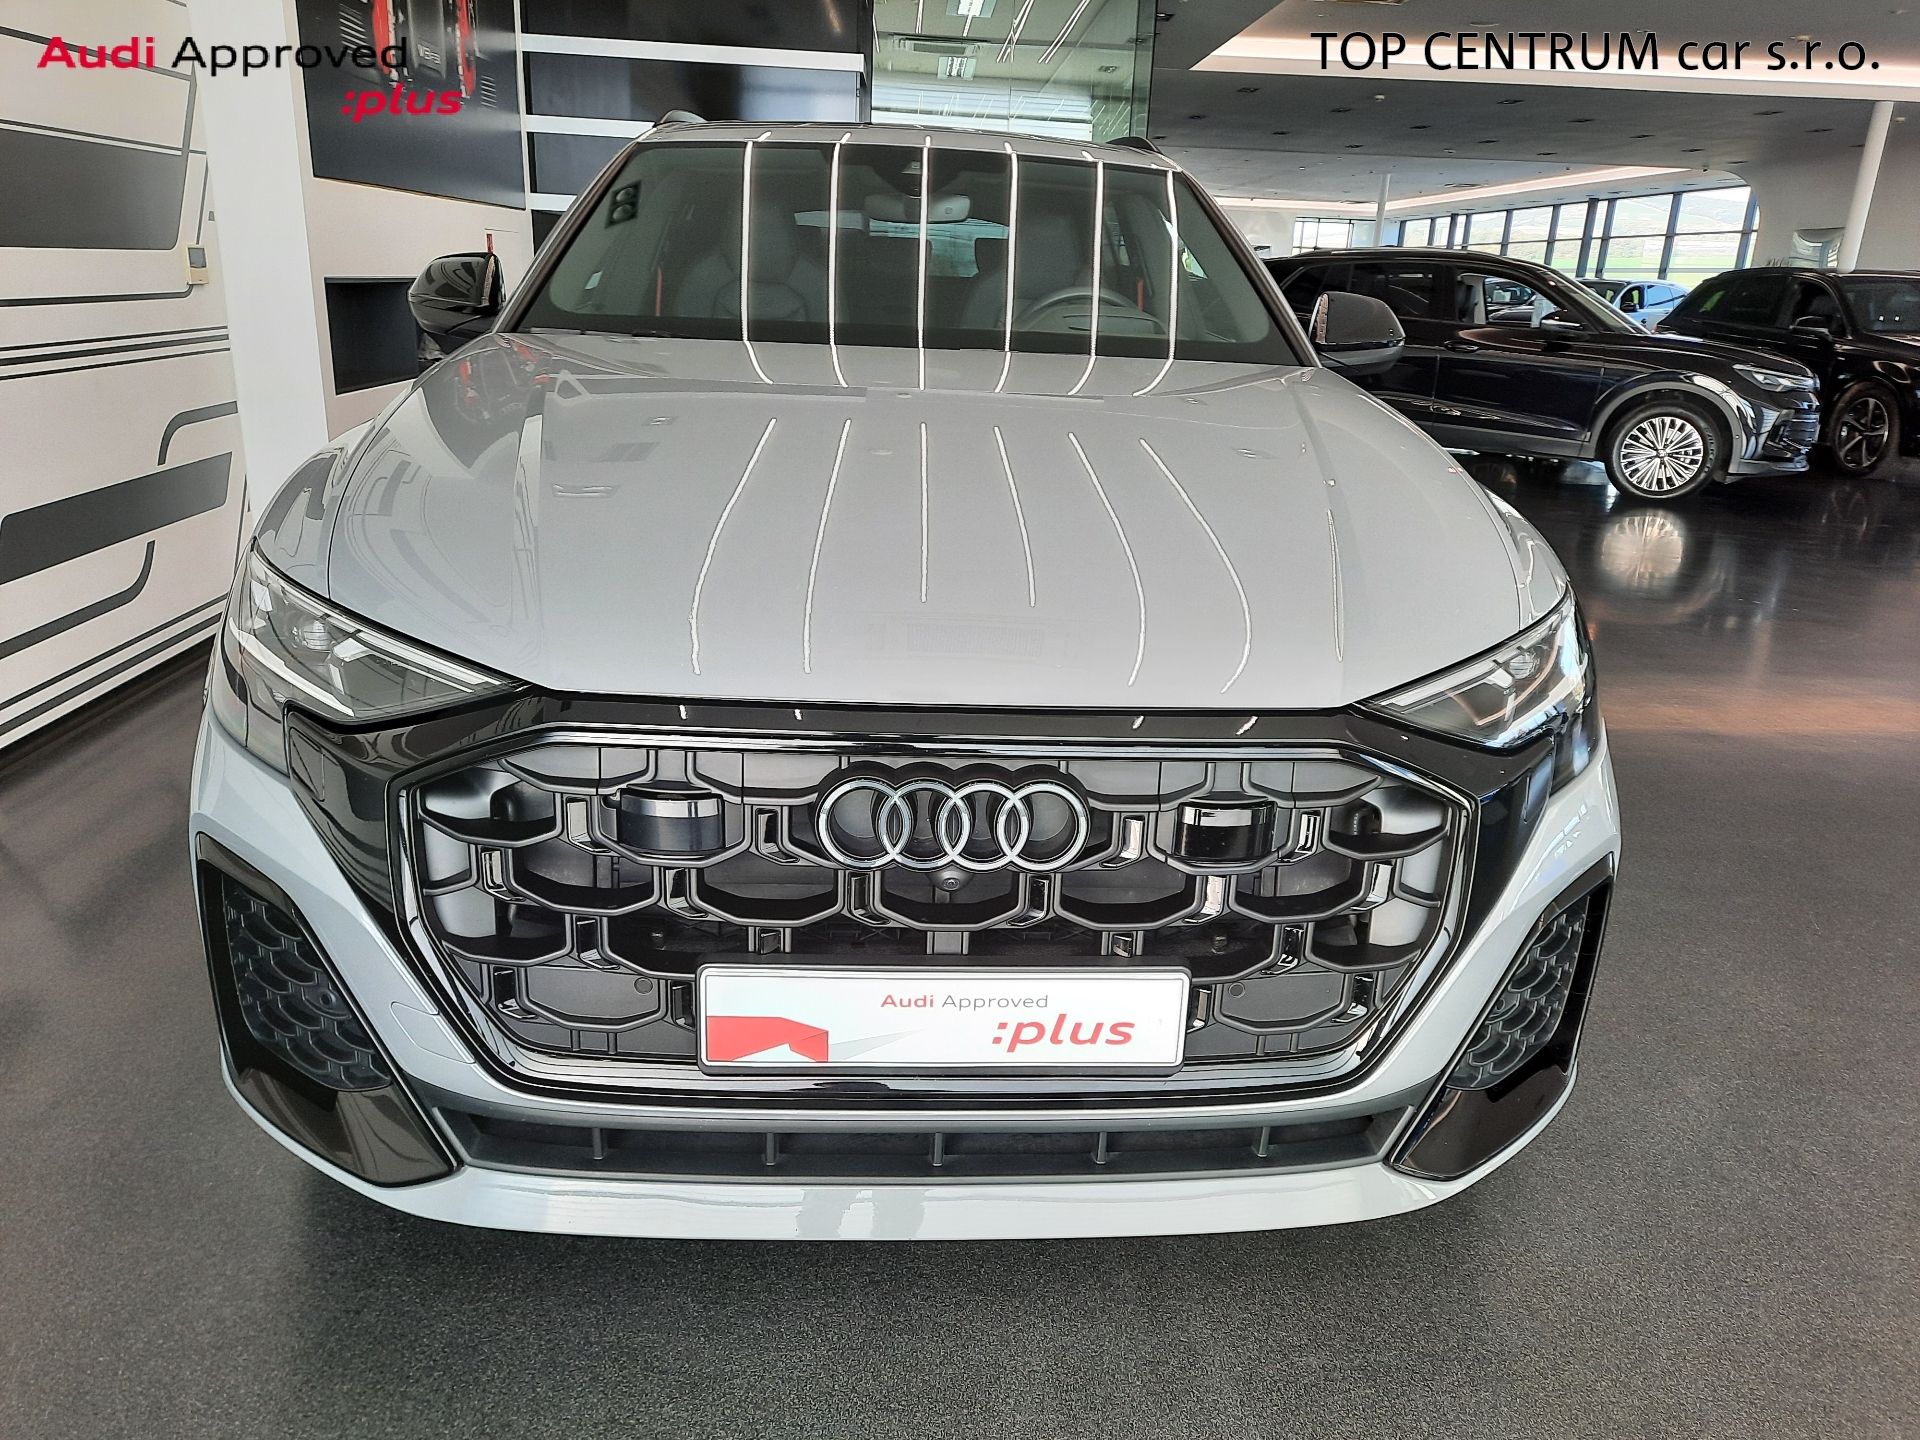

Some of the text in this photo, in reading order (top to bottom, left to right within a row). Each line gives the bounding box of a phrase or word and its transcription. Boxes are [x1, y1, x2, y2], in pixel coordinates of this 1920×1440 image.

[880, 994, 1049, 1010] Audi Approved
[992, 1014, 1135, 1053] :plus
